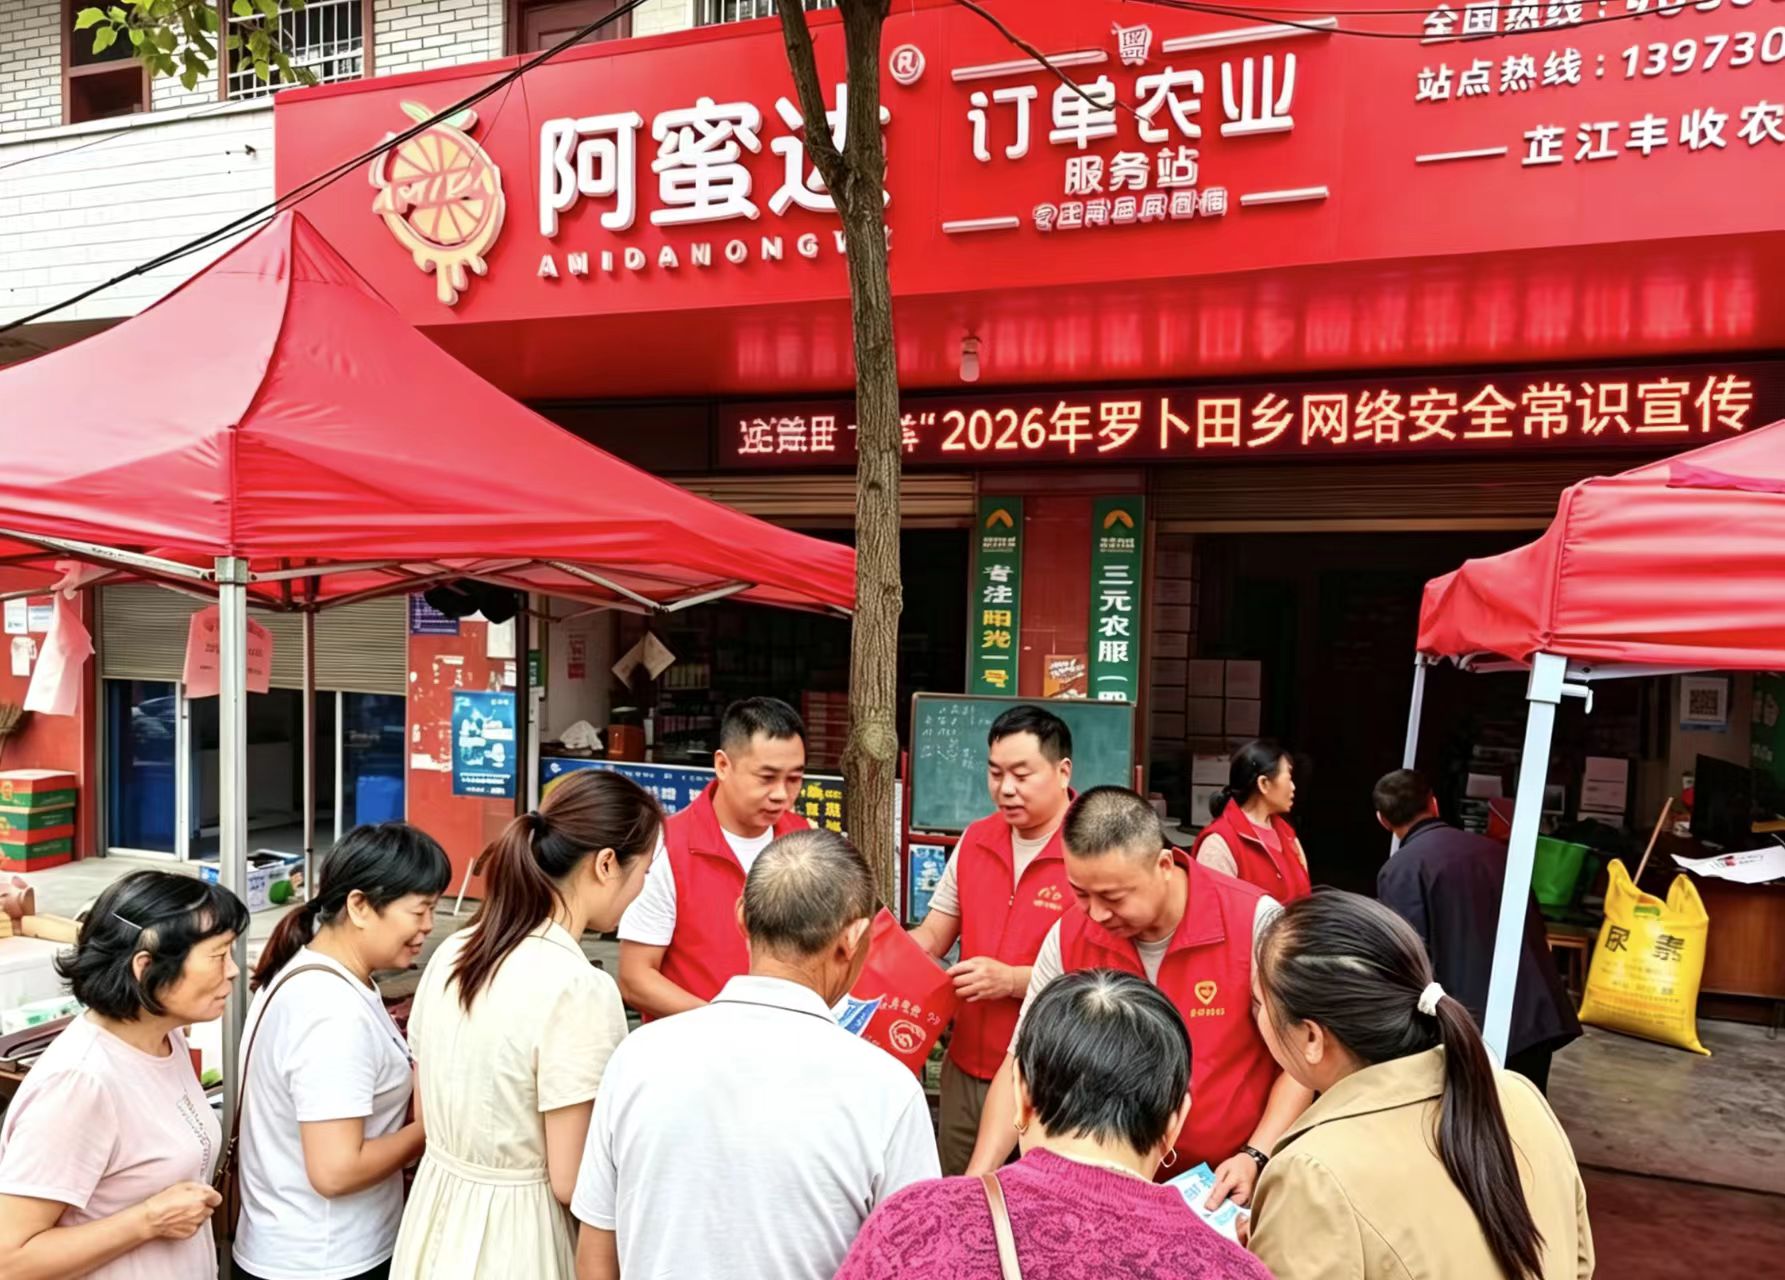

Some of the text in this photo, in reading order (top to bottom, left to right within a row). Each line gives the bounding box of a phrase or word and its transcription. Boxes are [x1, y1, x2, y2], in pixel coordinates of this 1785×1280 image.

[967, 52, 1297, 162] 订单农业
[1063, 145, 1201, 196] 服务站
